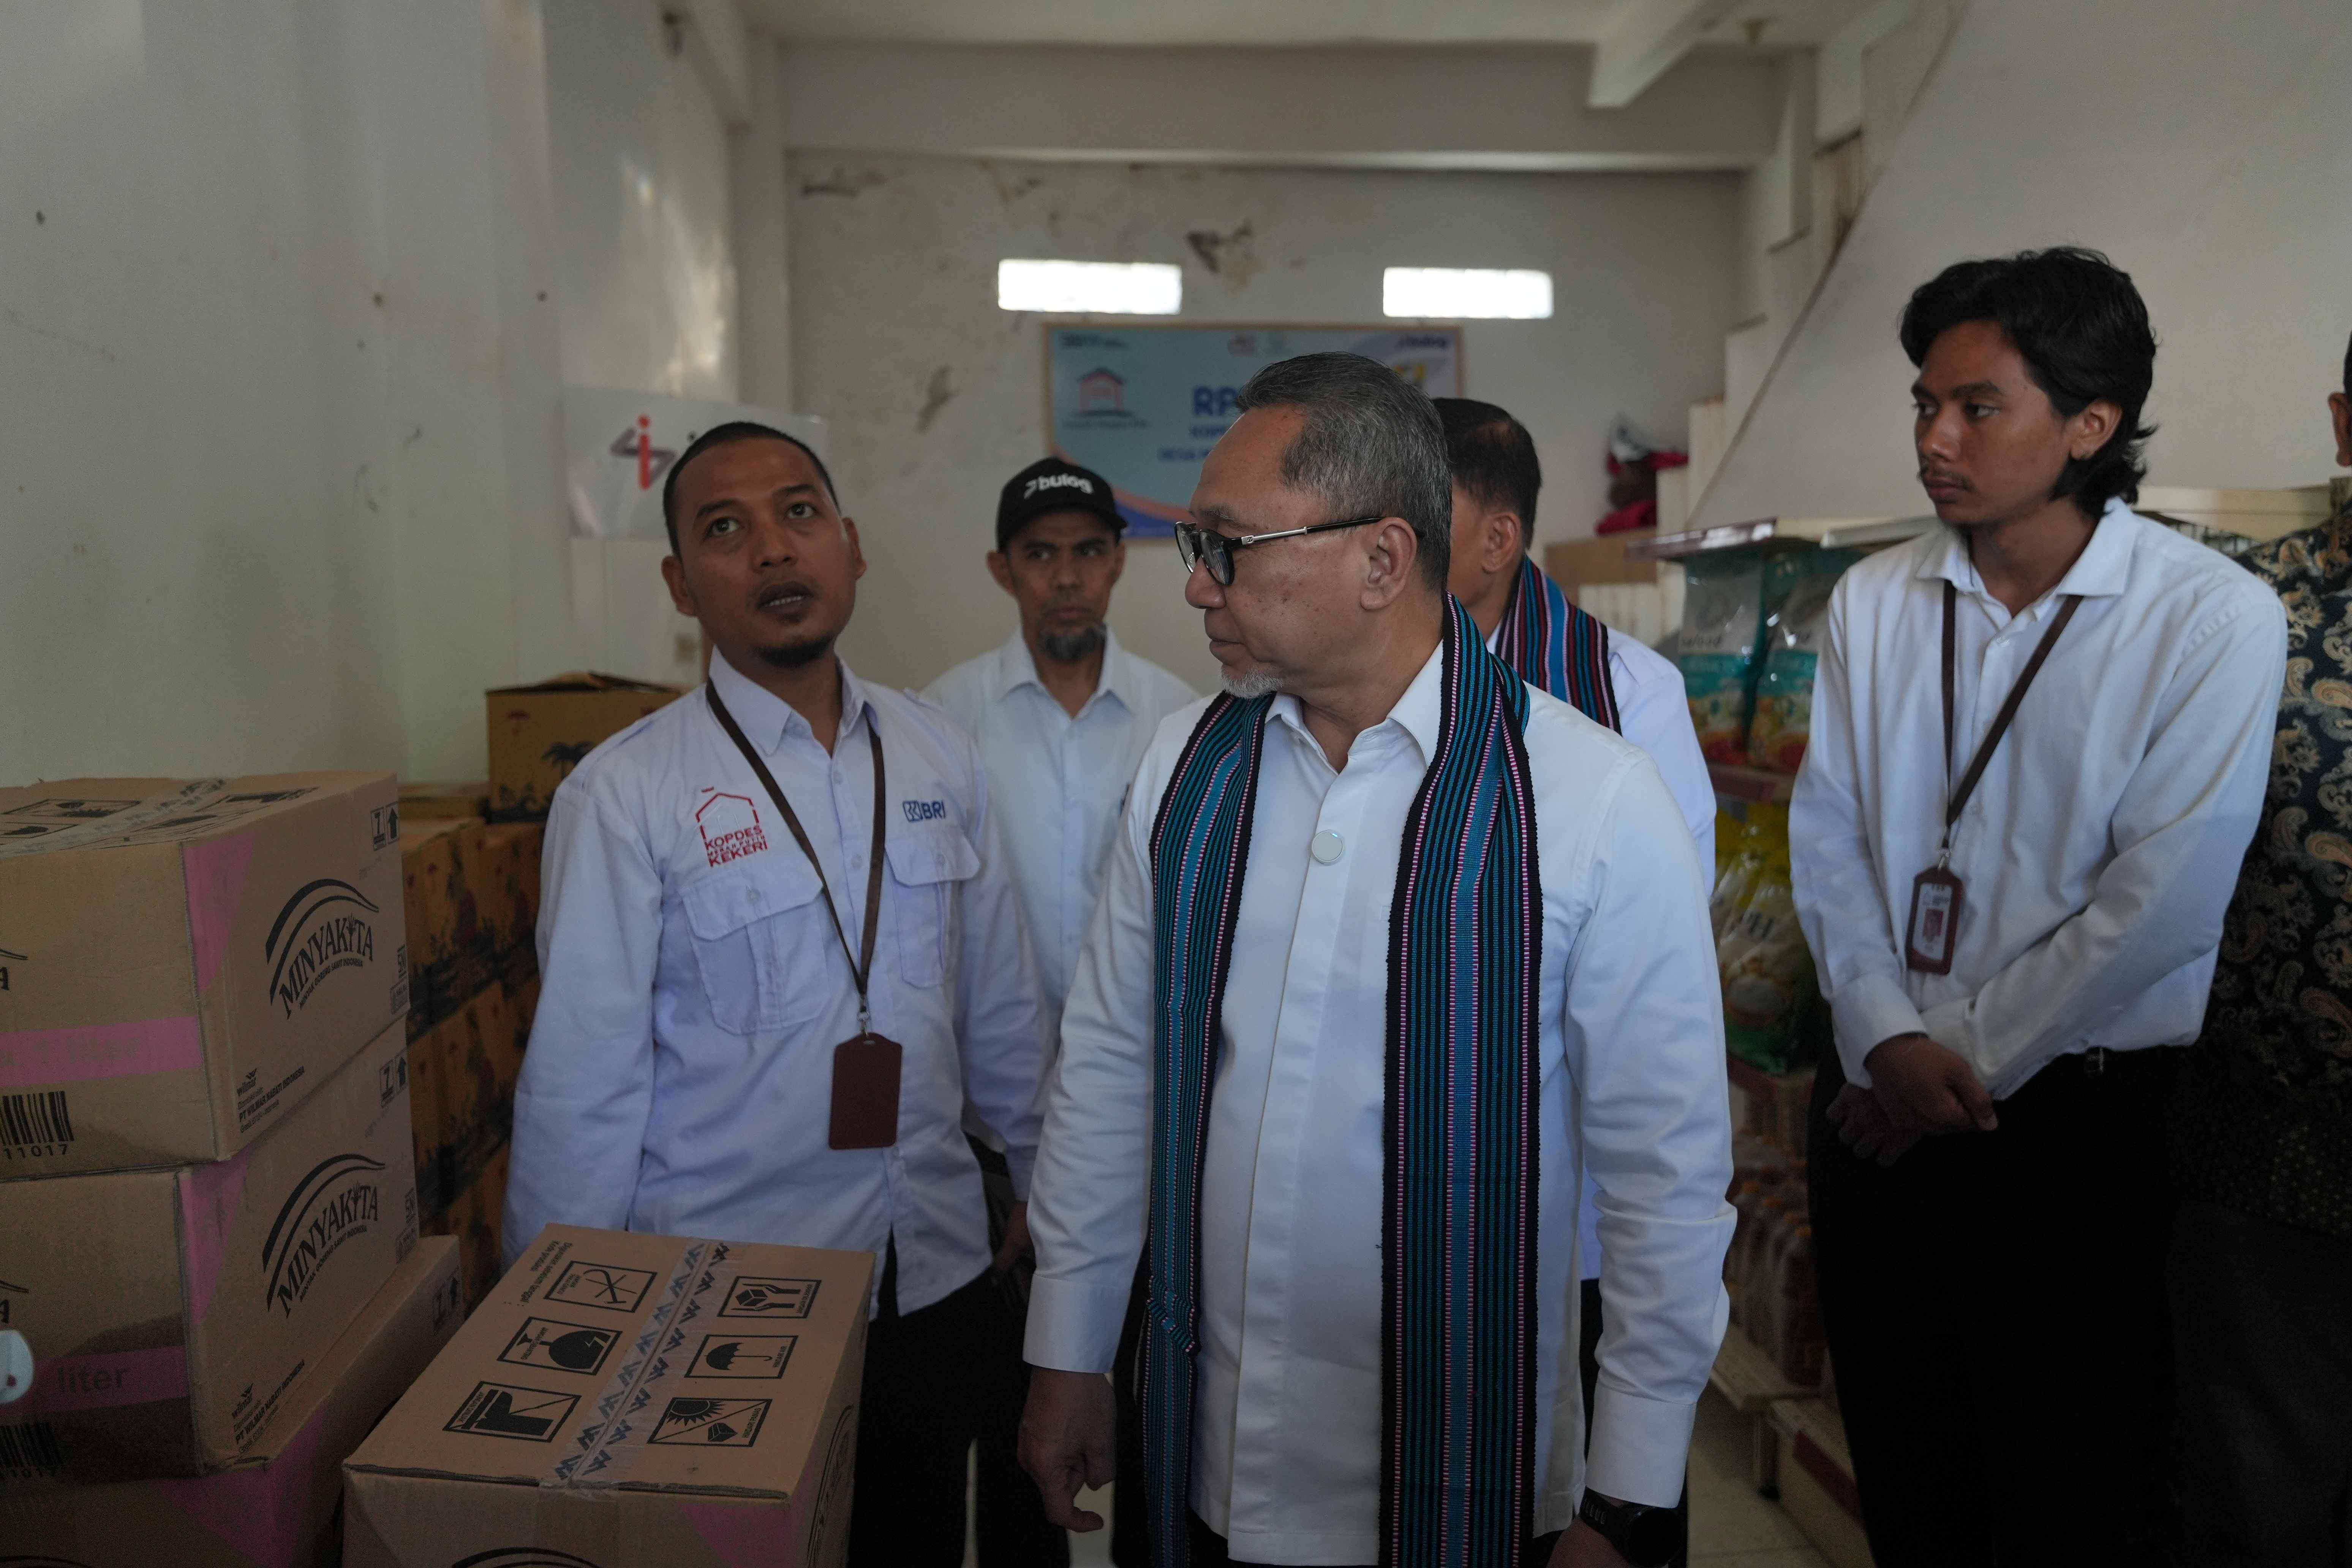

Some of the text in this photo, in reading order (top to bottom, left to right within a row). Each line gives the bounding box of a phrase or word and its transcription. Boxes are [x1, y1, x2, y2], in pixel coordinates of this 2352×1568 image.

[1193, 387, 1237, 416] RP
[1037, 474, 1093, 495] bulog
[922, 800, 945, 819] BRI
[705, 825, 762, 850] KOPDES
[709, 839, 768, 868] KEKERI
[279, 912, 373, 1020] MINYAKITA
[277, 1181, 378, 1319] MINYAKITA
[57, 1365, 130, 1394] liter
